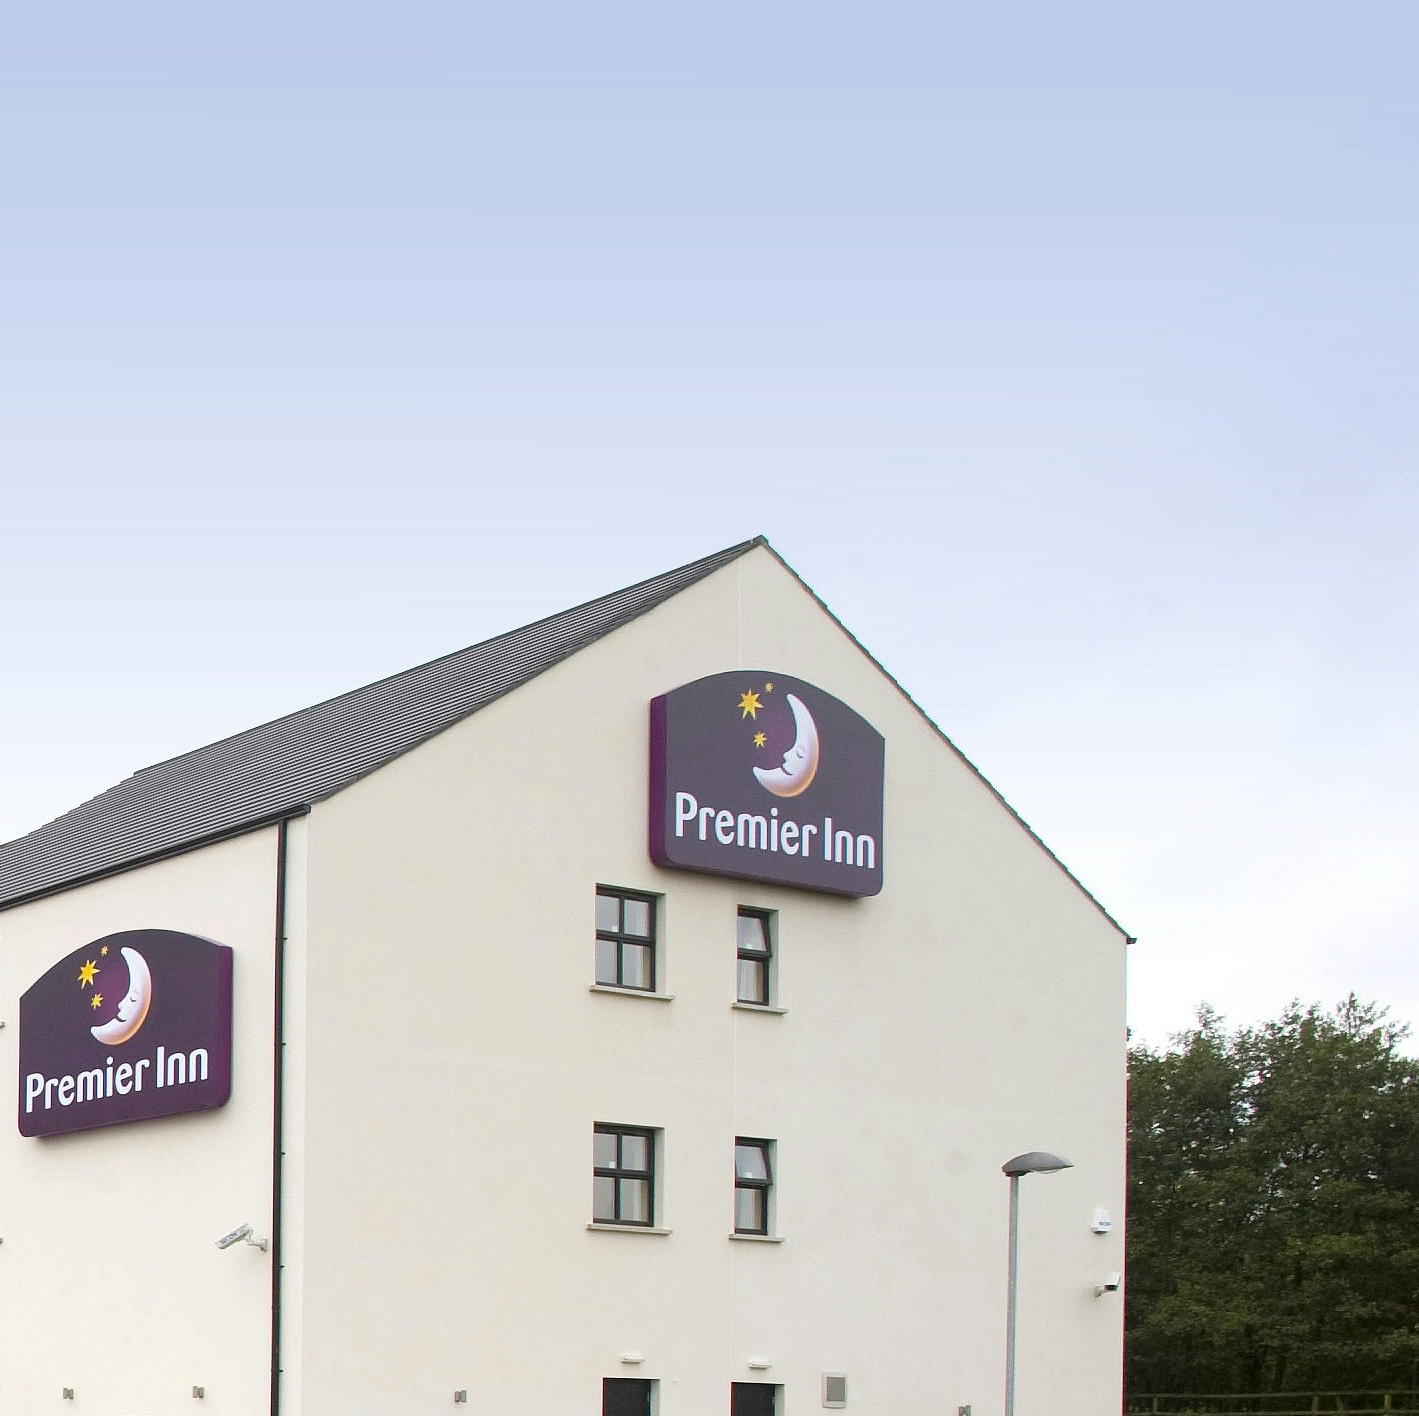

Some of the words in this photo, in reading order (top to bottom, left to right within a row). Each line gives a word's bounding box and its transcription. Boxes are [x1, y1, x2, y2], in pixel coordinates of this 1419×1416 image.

[675, 792, 818, 858] Premier
[824, 817, 875, 869] Inn
[25, 1056, 150, 1114] Premier
[156, 1046, 209, 1088] Inn
